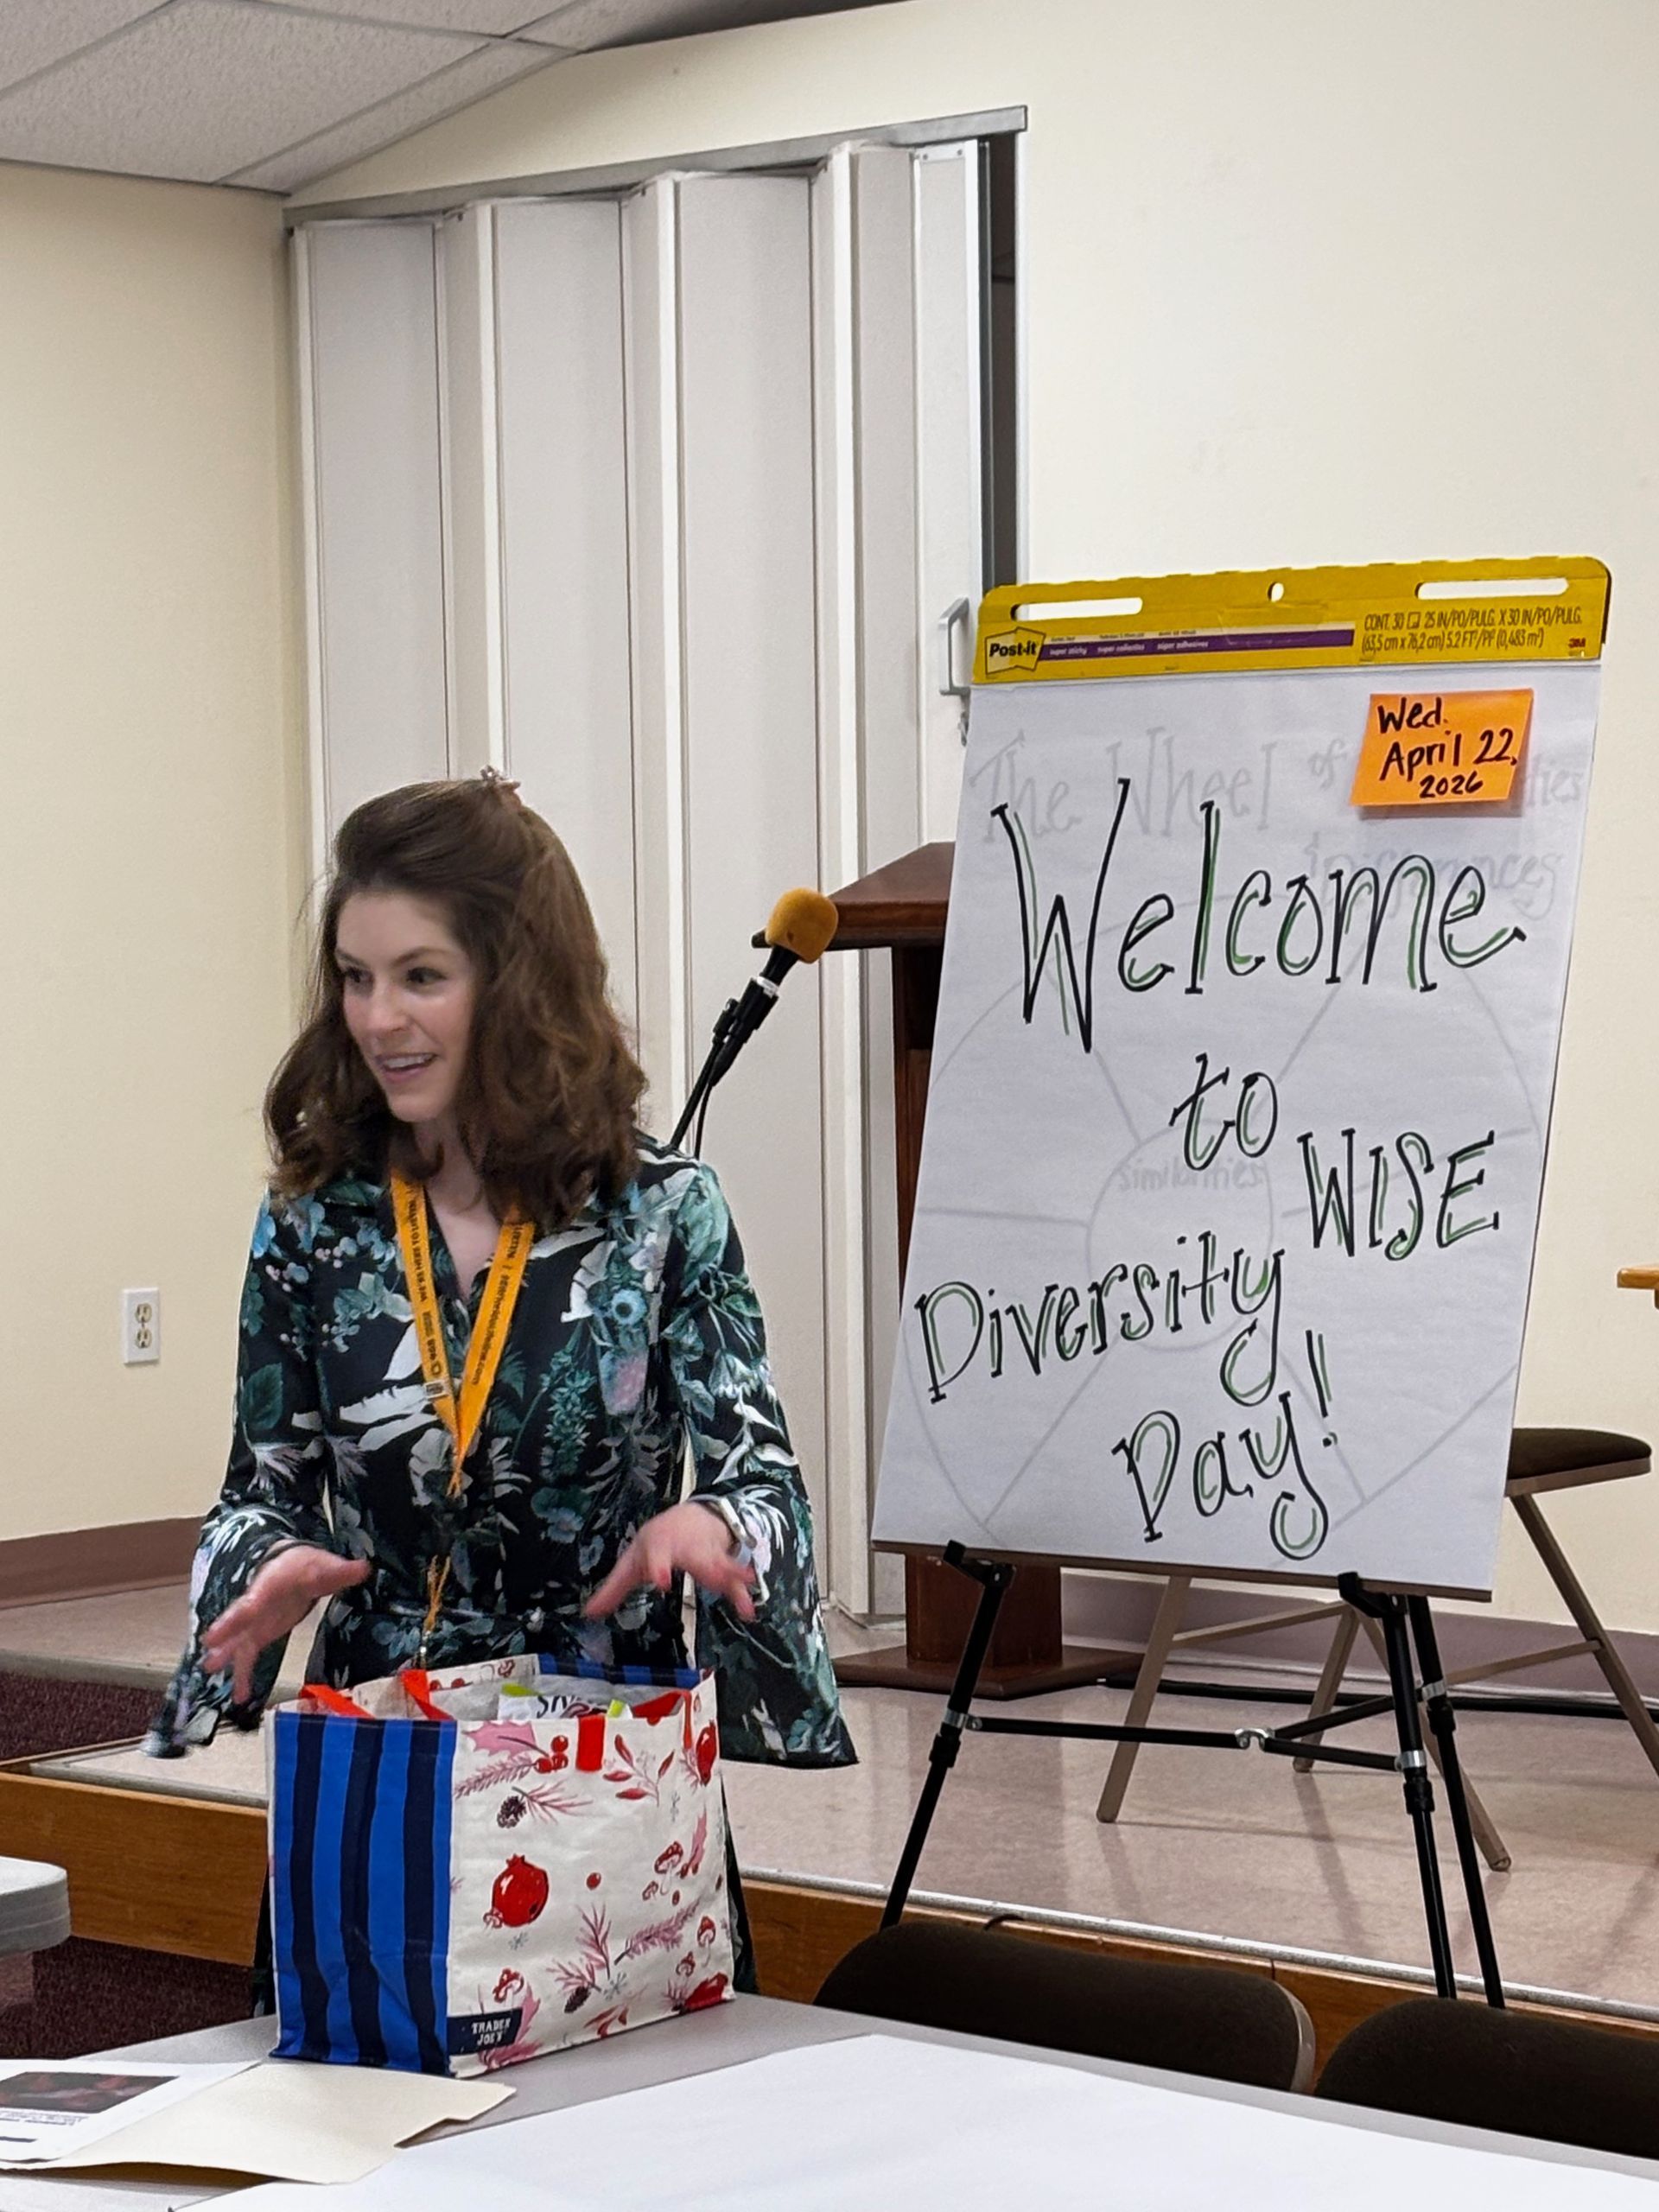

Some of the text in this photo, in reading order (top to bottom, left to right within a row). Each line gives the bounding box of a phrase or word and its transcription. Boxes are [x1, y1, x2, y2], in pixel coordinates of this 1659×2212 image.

[989, 639, 1037, 658] Post-it
[1383, 637, 1398, 651] cm
[1392, 612, 1405, 631] 30
[1424, 611, 1435, 629] 25
[1507, 607, 1520, 626] 30
[1377, 696, 1449, 734] Wed.
[1379, 728, 1518, 782] April 22,
[969, 728, 1083, 843] The
[1419, 770, 1484, 798] 2026
[990, 777, 1527, 1054] Welcome
[1168, 1052, 1279, 1171] to
[1296, 1127, 1500, 1261] WISE
[914, 1230, 1286, 1408] Diversity
[1111, 1329, 1340, 1562] Day!
